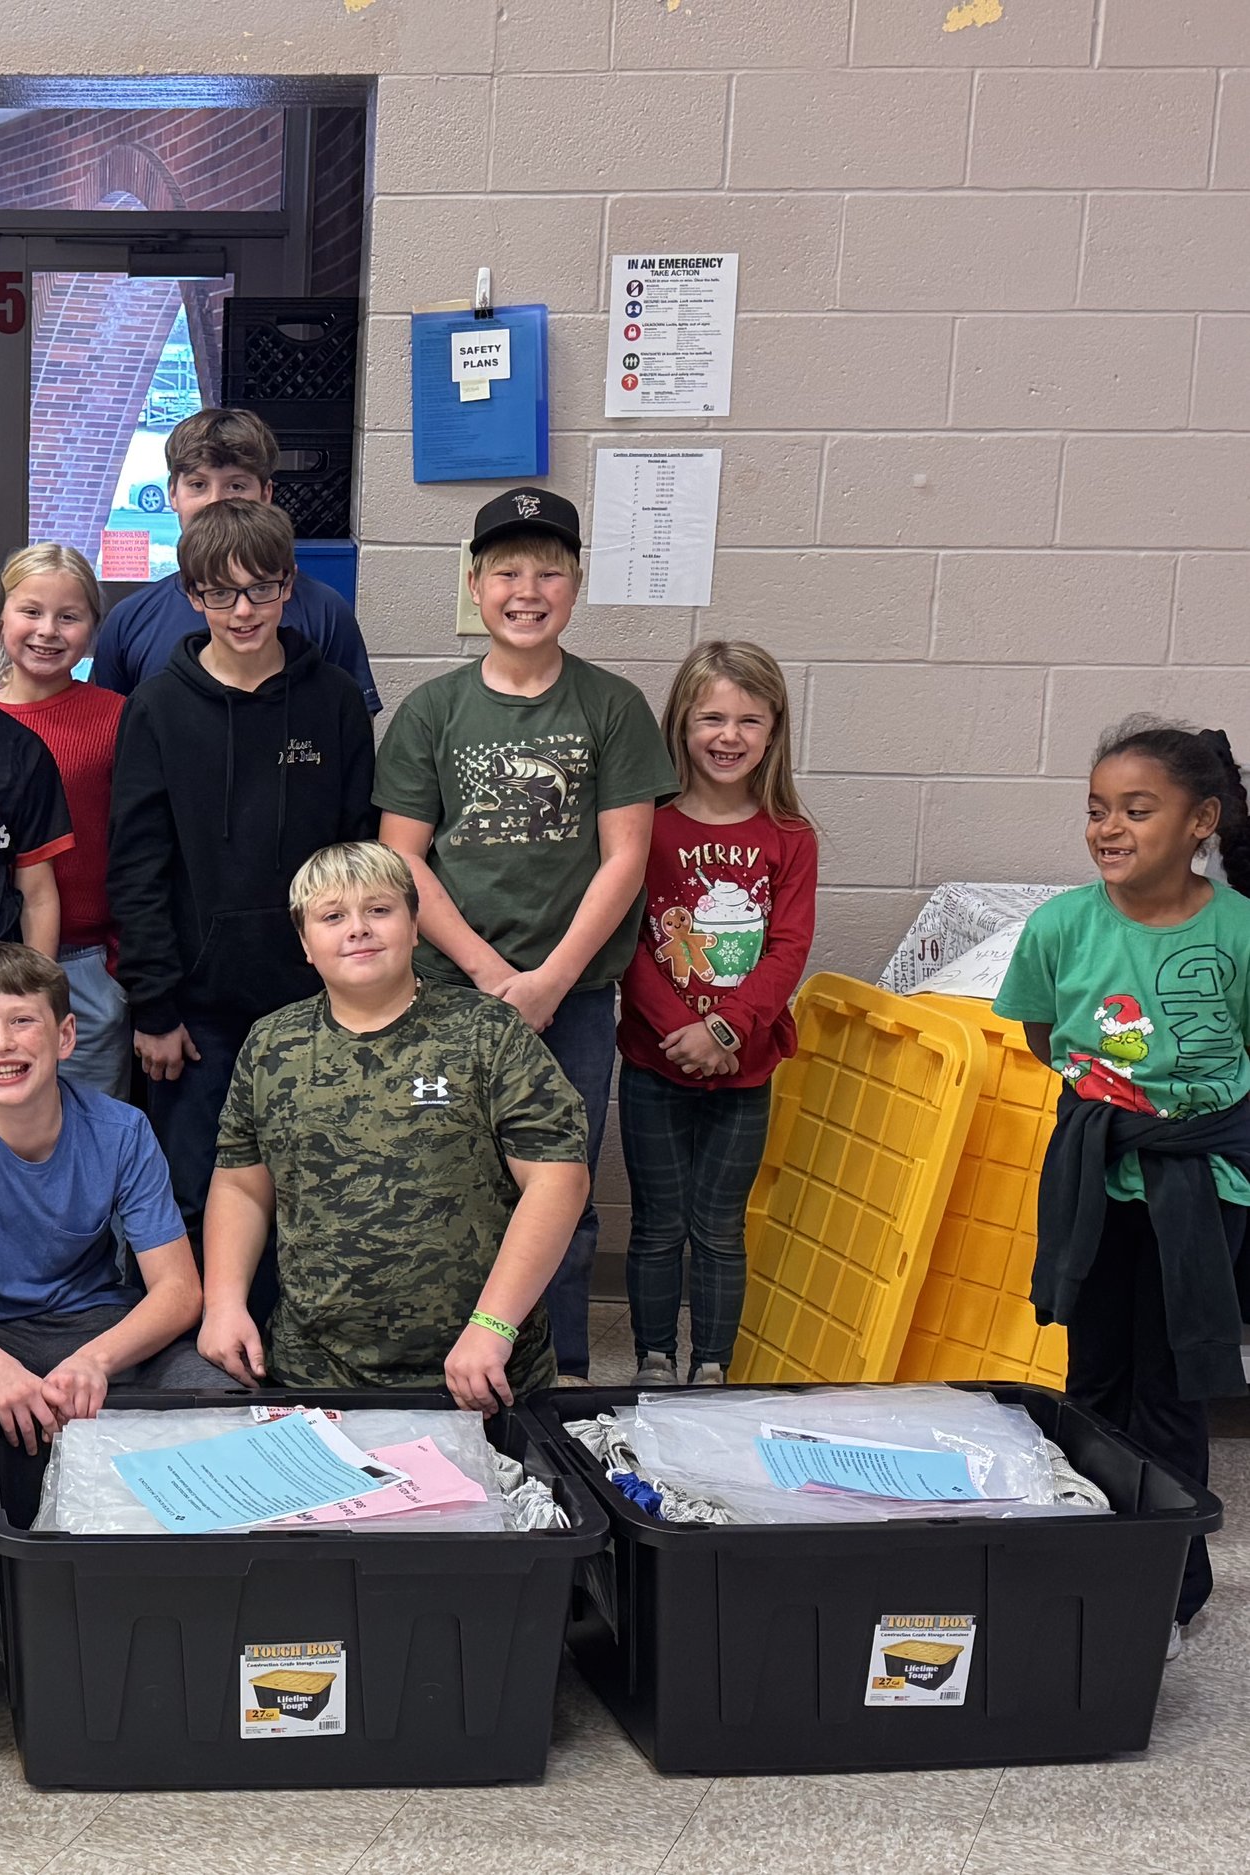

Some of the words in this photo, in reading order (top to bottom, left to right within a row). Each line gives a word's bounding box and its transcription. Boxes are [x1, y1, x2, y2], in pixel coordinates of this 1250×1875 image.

[628, 260, 638, 269] IN
[641, 259, 655, 269] AN
[659, 258, 723, 269] EMERGENCY
[460, 344, 501, 355] SAFETY
[463, 359, 498, 368] PLANS
[677, 843, 761, 869] MERRY
[485, 1317, 508, 1331] SKY
[887, 1617, 934, 1628] TOUGH
[939, 1617, 968, 1627] BOX
[252, 1644, 301, 1658] TOUGH
[306, 1643, 338, 1656] BOX
[904, 1665, 938, 1673] Lifetime
[908, 1672, 934, 1681] Tough
[878, 1678, 892, 1686] 27
[277, 1695, 313, 1703] Lifetime
[282, 1702, 308, 1711] Tough
[252, 1710, 265, 1718] 27
